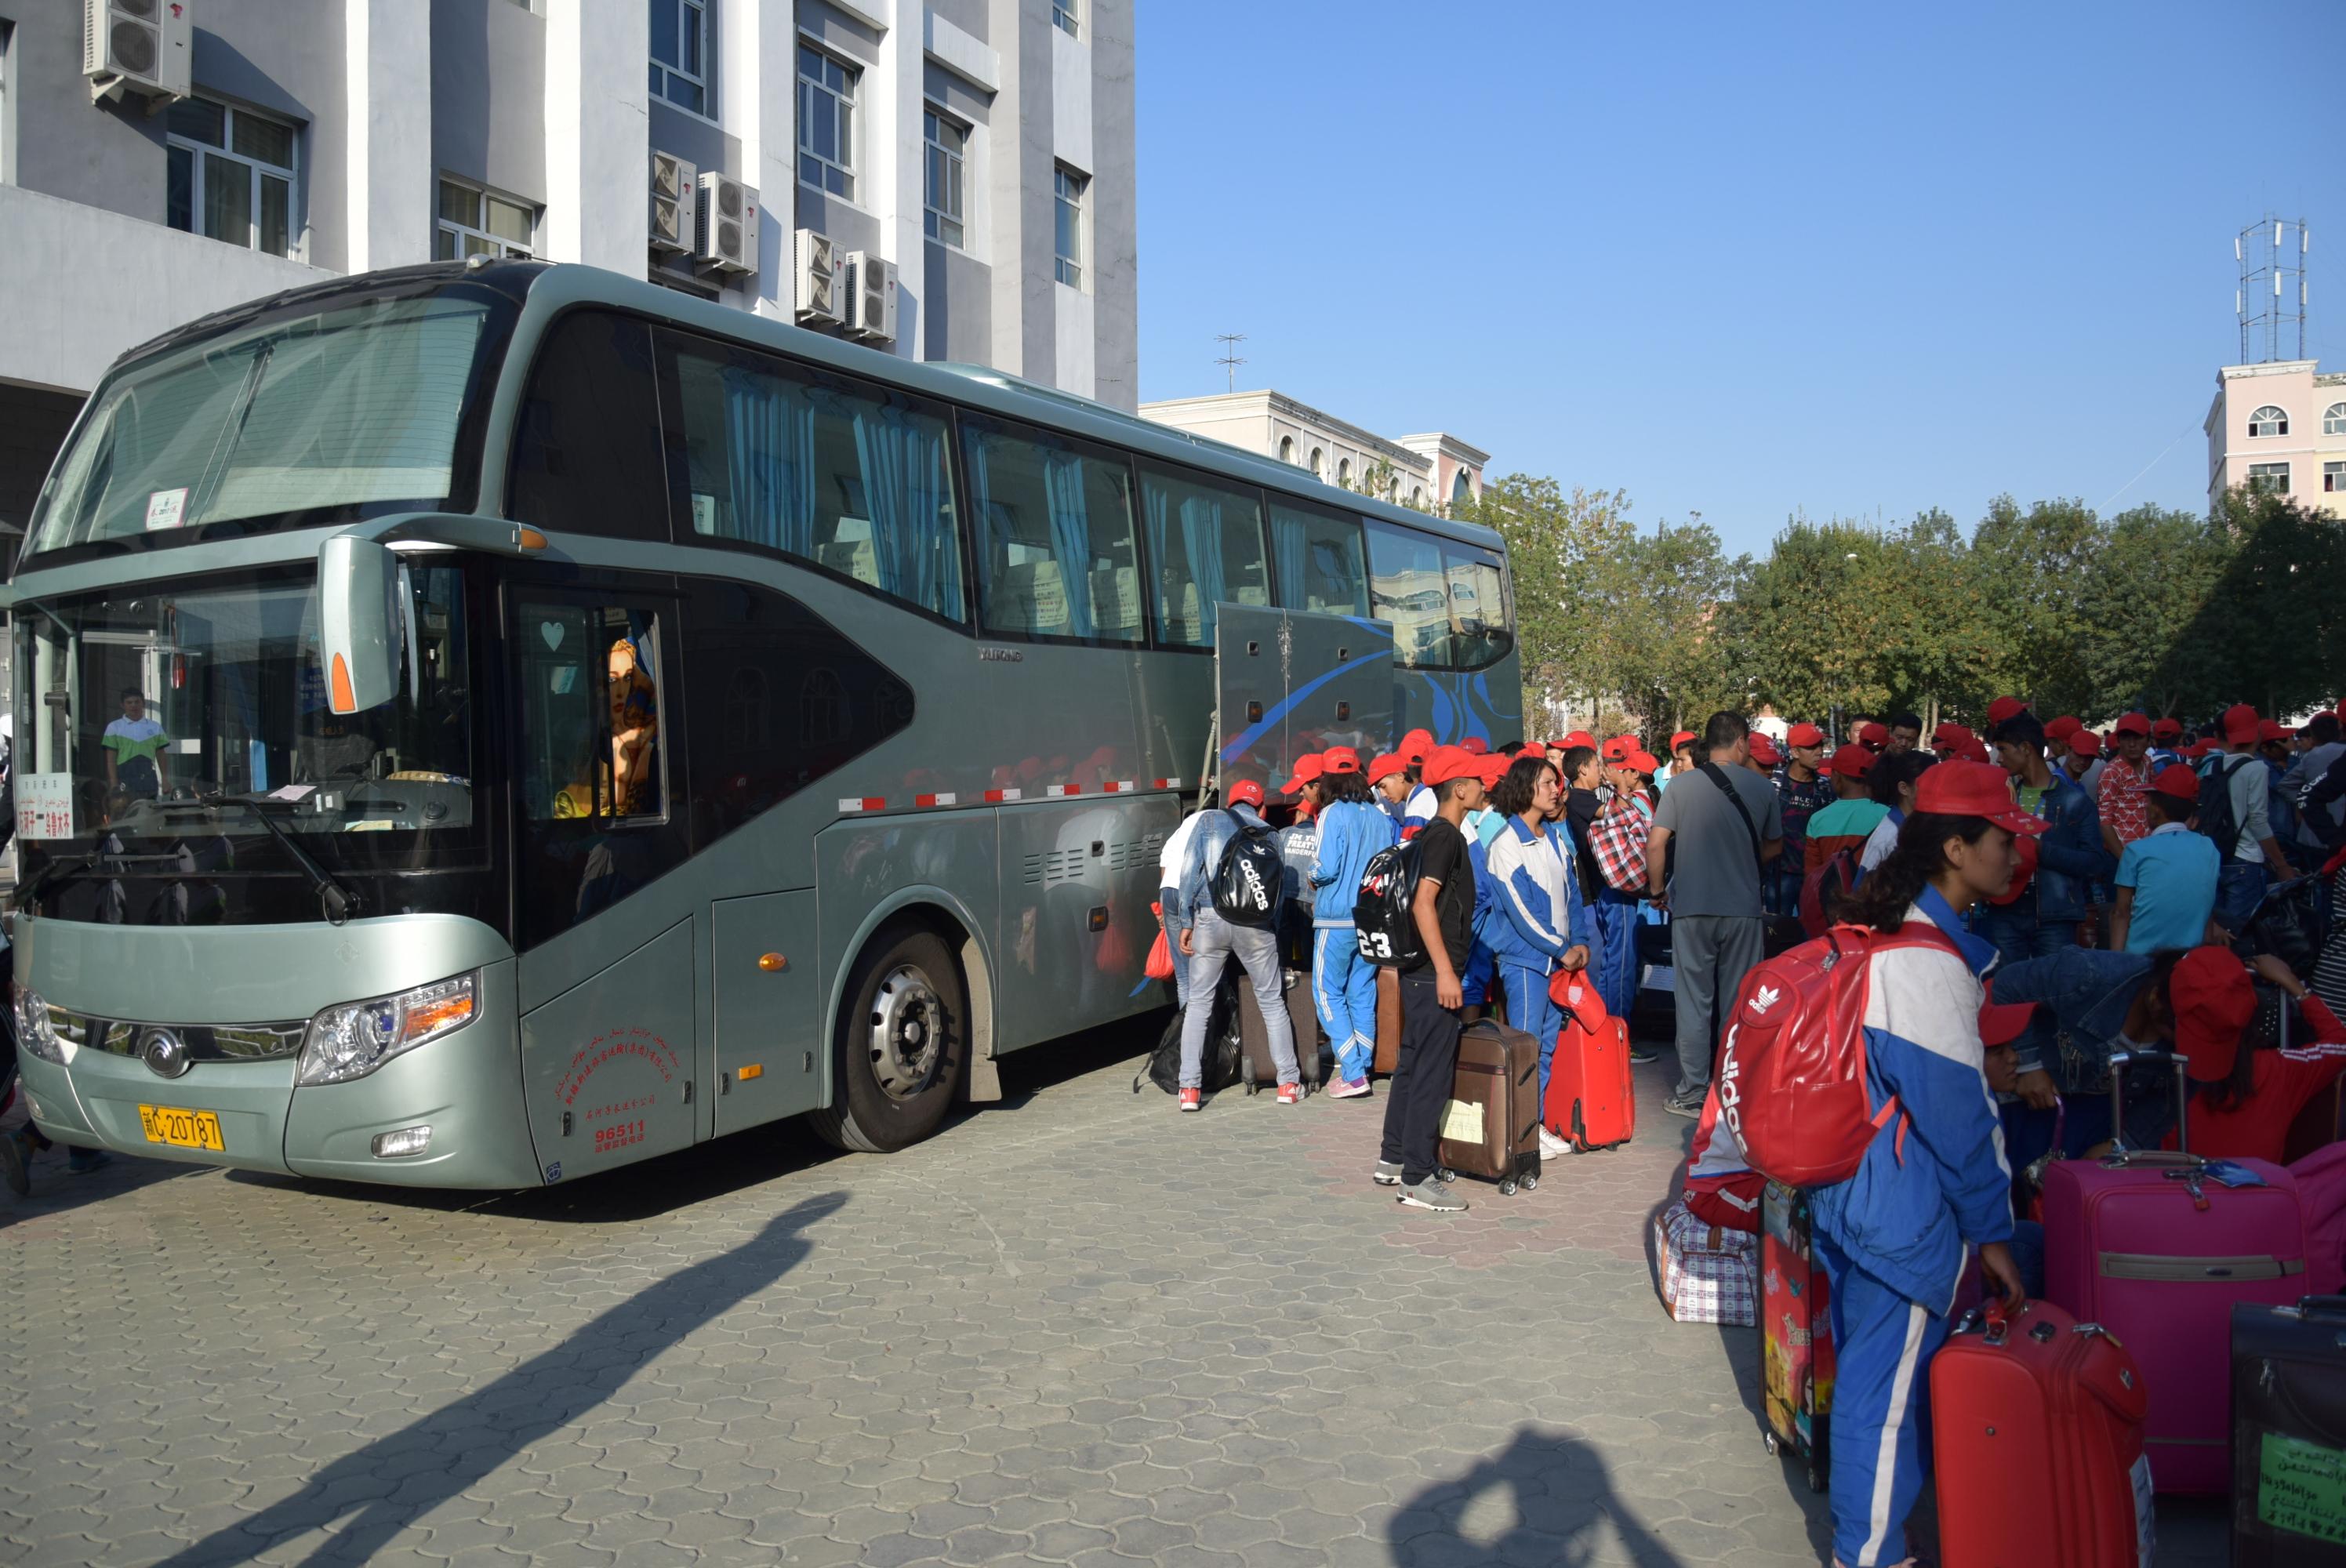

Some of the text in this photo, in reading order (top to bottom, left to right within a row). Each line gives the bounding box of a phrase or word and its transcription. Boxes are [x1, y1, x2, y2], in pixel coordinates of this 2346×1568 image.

[1240, 858, 1269, 911] adidas
[1356, 927, 1392, 959] 23
[595, 1119, 645, 1143] 96511
